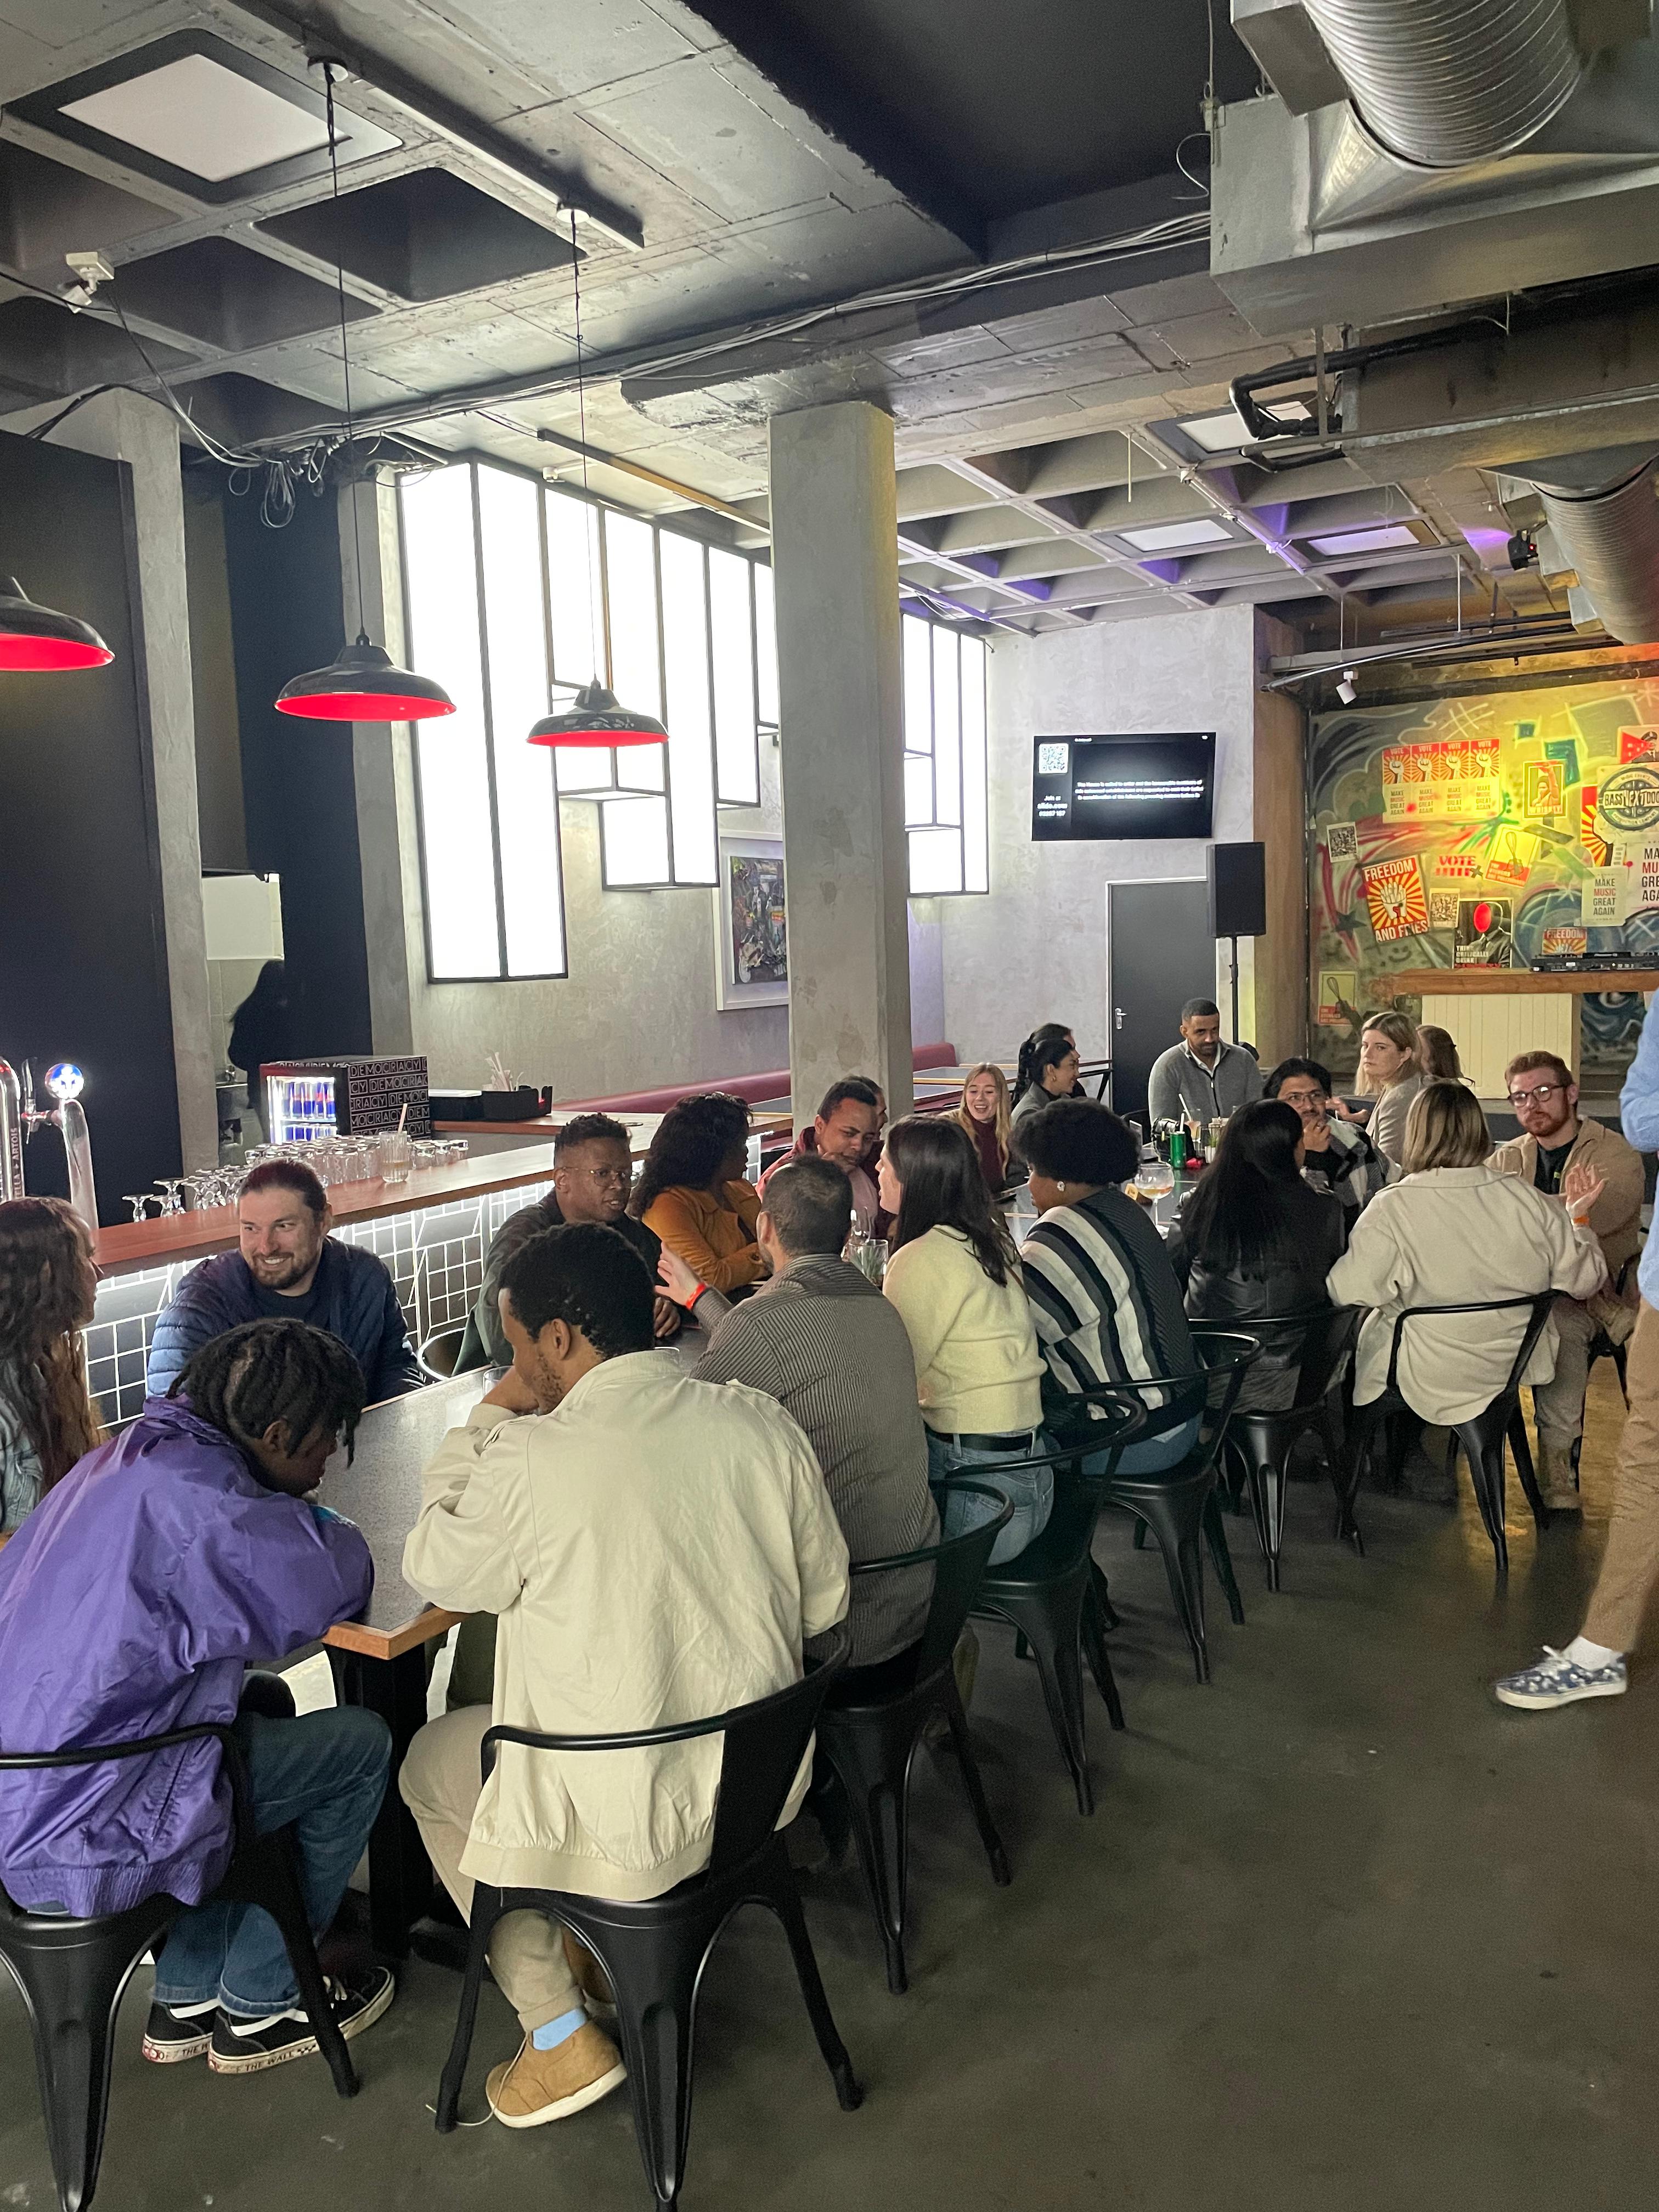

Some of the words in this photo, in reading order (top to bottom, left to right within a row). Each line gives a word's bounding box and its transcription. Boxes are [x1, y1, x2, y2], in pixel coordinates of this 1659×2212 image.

[1605, 793, 1623, 806] BASS
[1438, 855, 1476, 866] VOTE
[1364, 859, 1414, 882] FREEDOM
[1595, 878, 1615, 887] MAKE
[1594, 888, 1616, 896] MUSIC
[1593, 898, 1616, 906] GREAT
[1593, 907, 1615, 916] AGAIN
[1375, 927, 1396, 942] AND
[1547, 929, 1583, 939] FREEDOM
[351, 1060, 420, 1076] DEMOCRACY
[10, 1127, 19, 1160] ARTOIS
[245, 2062, 263, 2072] THE
[267, 2051, 295, 2065] WALL
